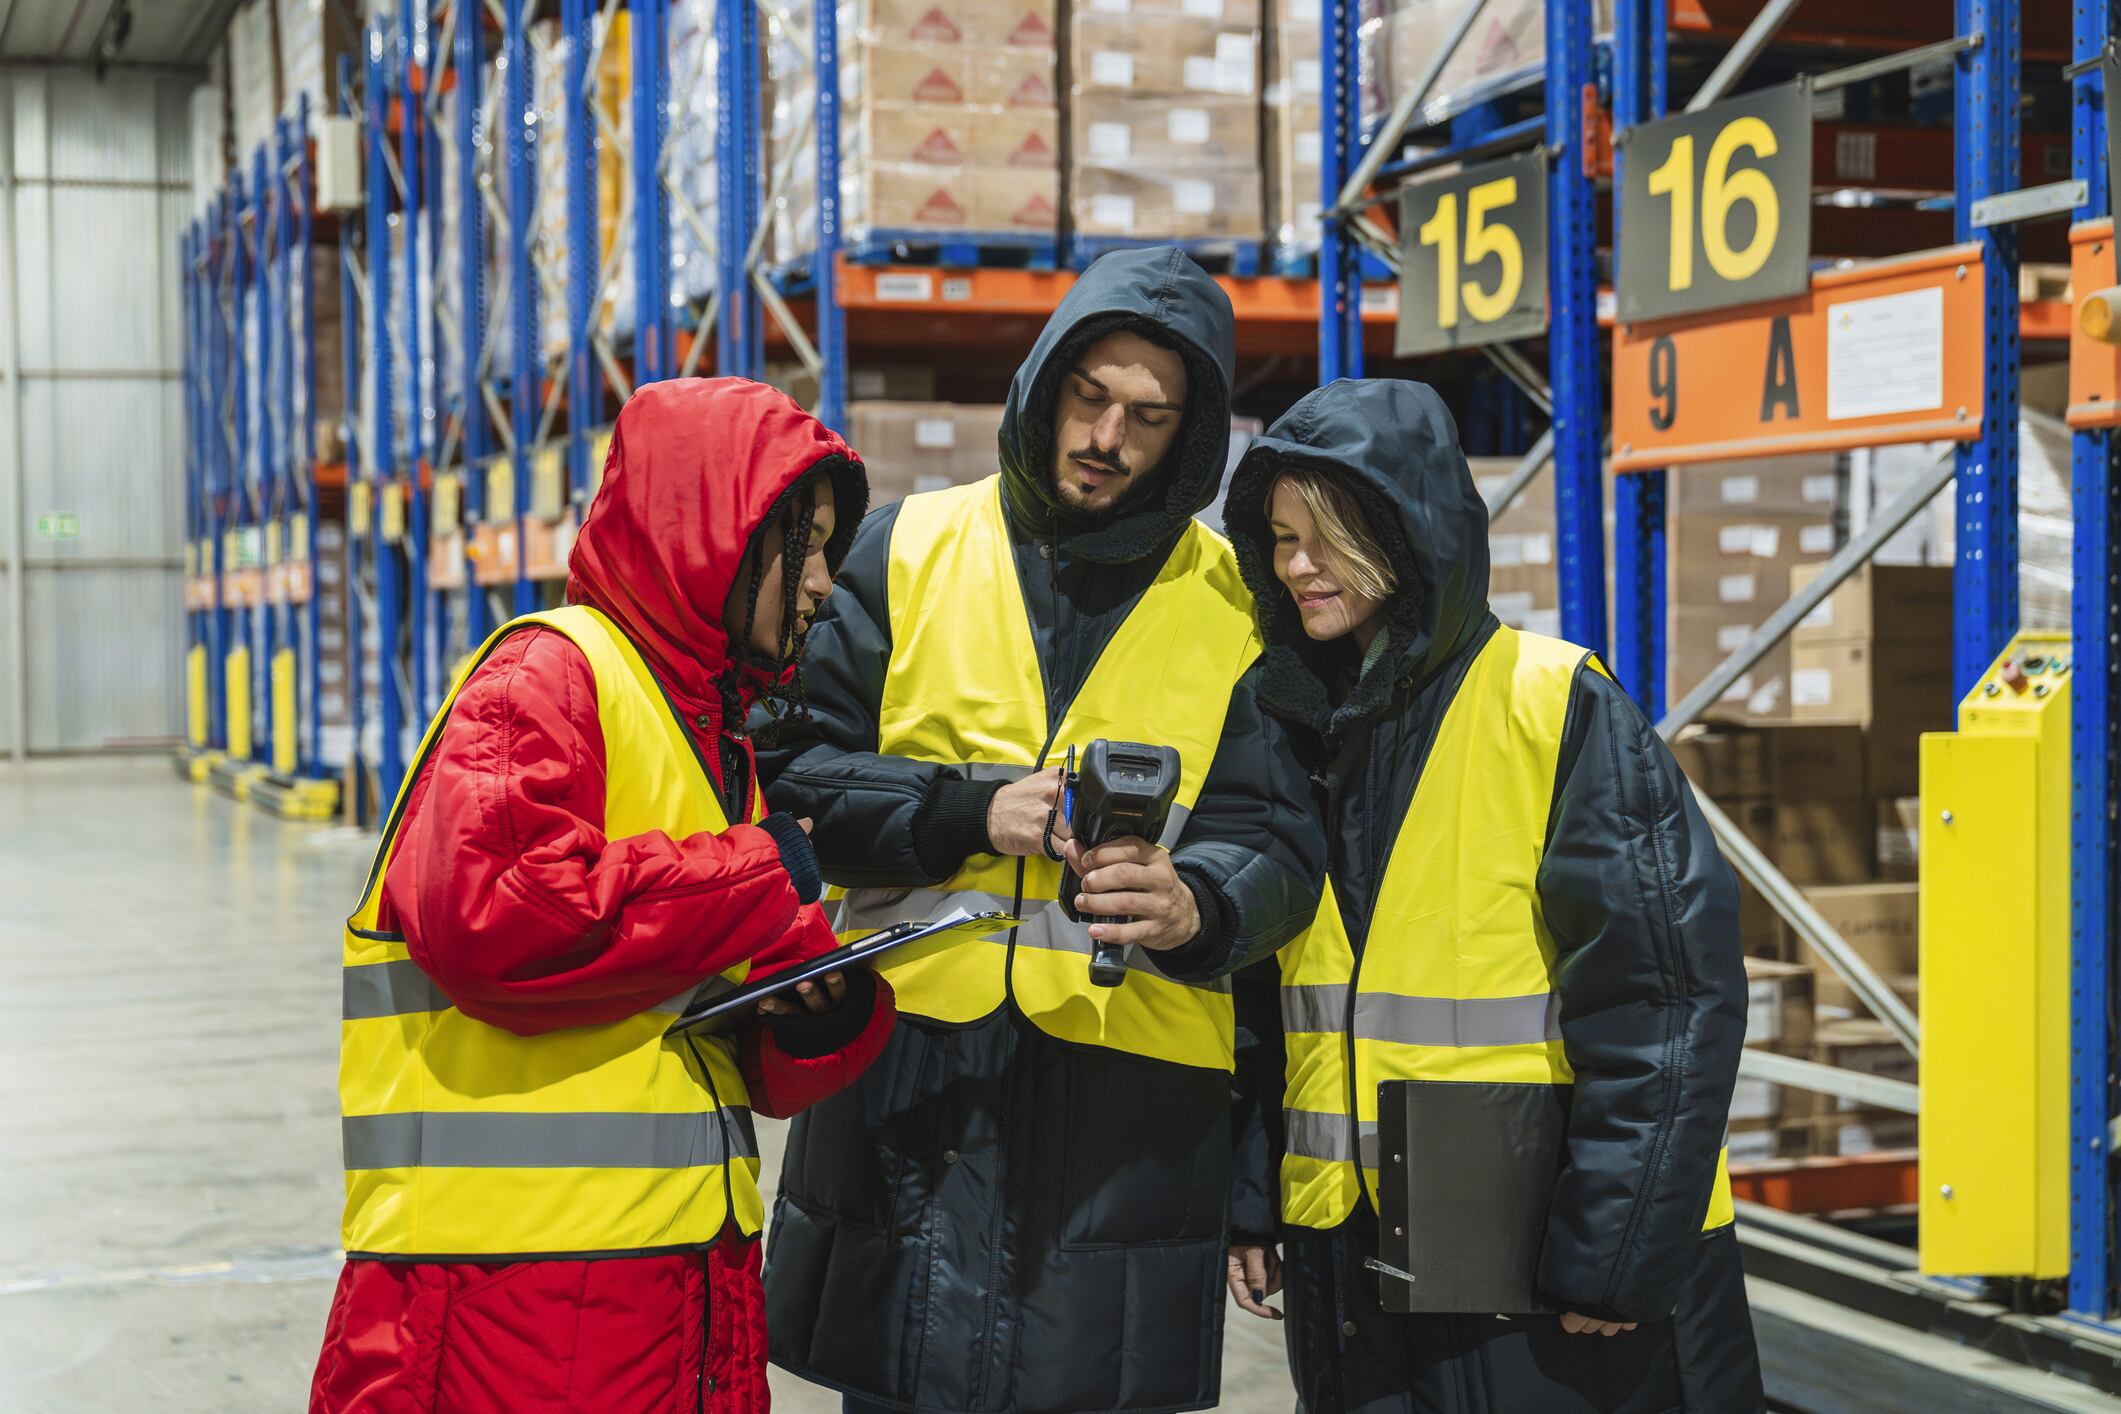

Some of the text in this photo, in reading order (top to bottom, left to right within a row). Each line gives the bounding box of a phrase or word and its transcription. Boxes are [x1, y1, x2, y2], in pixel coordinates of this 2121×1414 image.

[1420, 176, 1524, 329] 15
[1648, 116, 1781, 290] 16
[1649, 332, 1677, 431] 9
[1761, 314, 1800, 421] A
